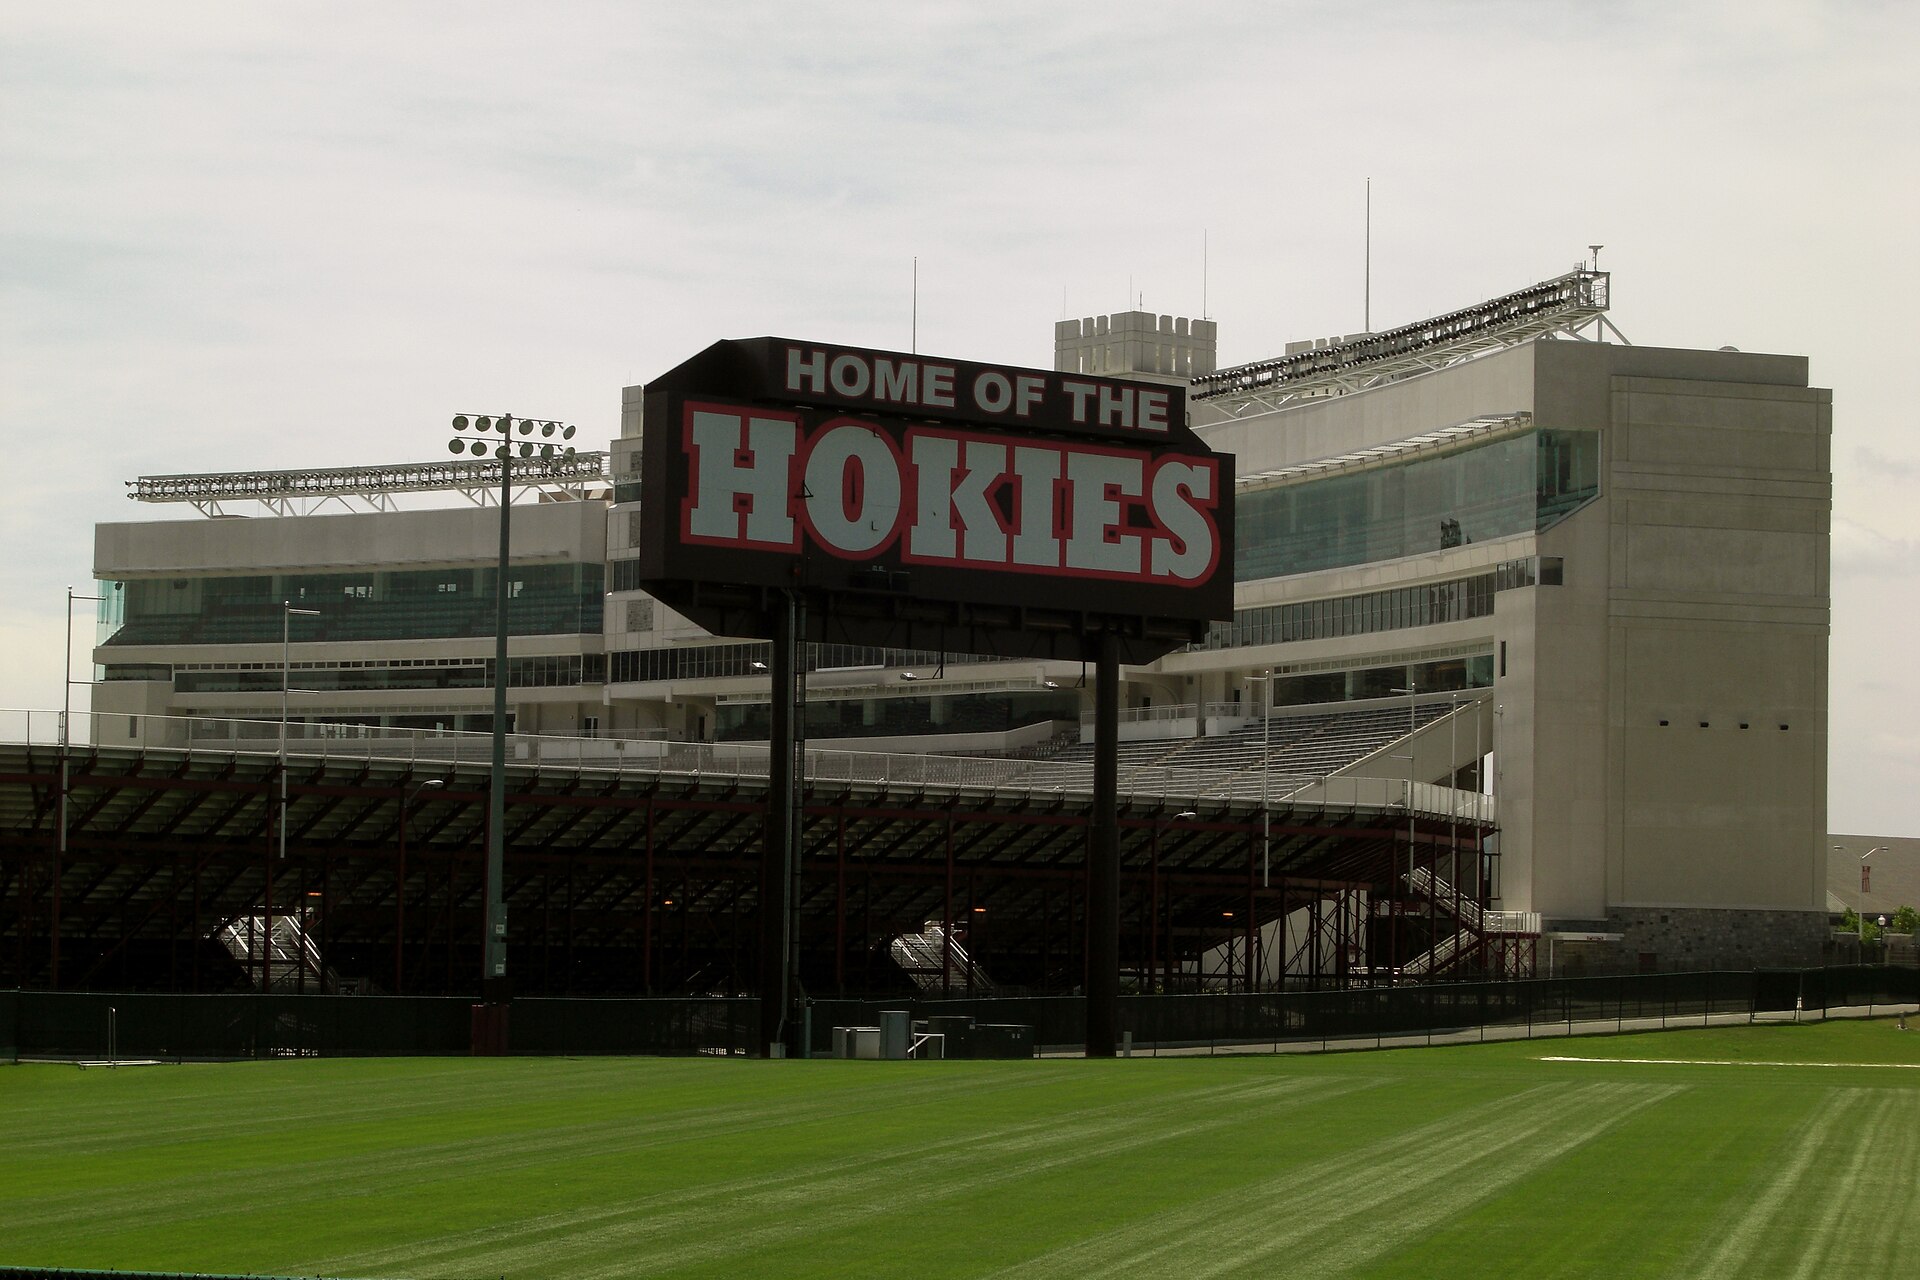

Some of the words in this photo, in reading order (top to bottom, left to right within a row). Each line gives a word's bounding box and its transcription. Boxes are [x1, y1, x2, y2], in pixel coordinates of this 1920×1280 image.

[786, 347, 956, 408] HOME
[973, 371, 1046, 417] OF
[1062, 380, 1169, 432] THE
[682, 402, 1218, 587] HOKIES
